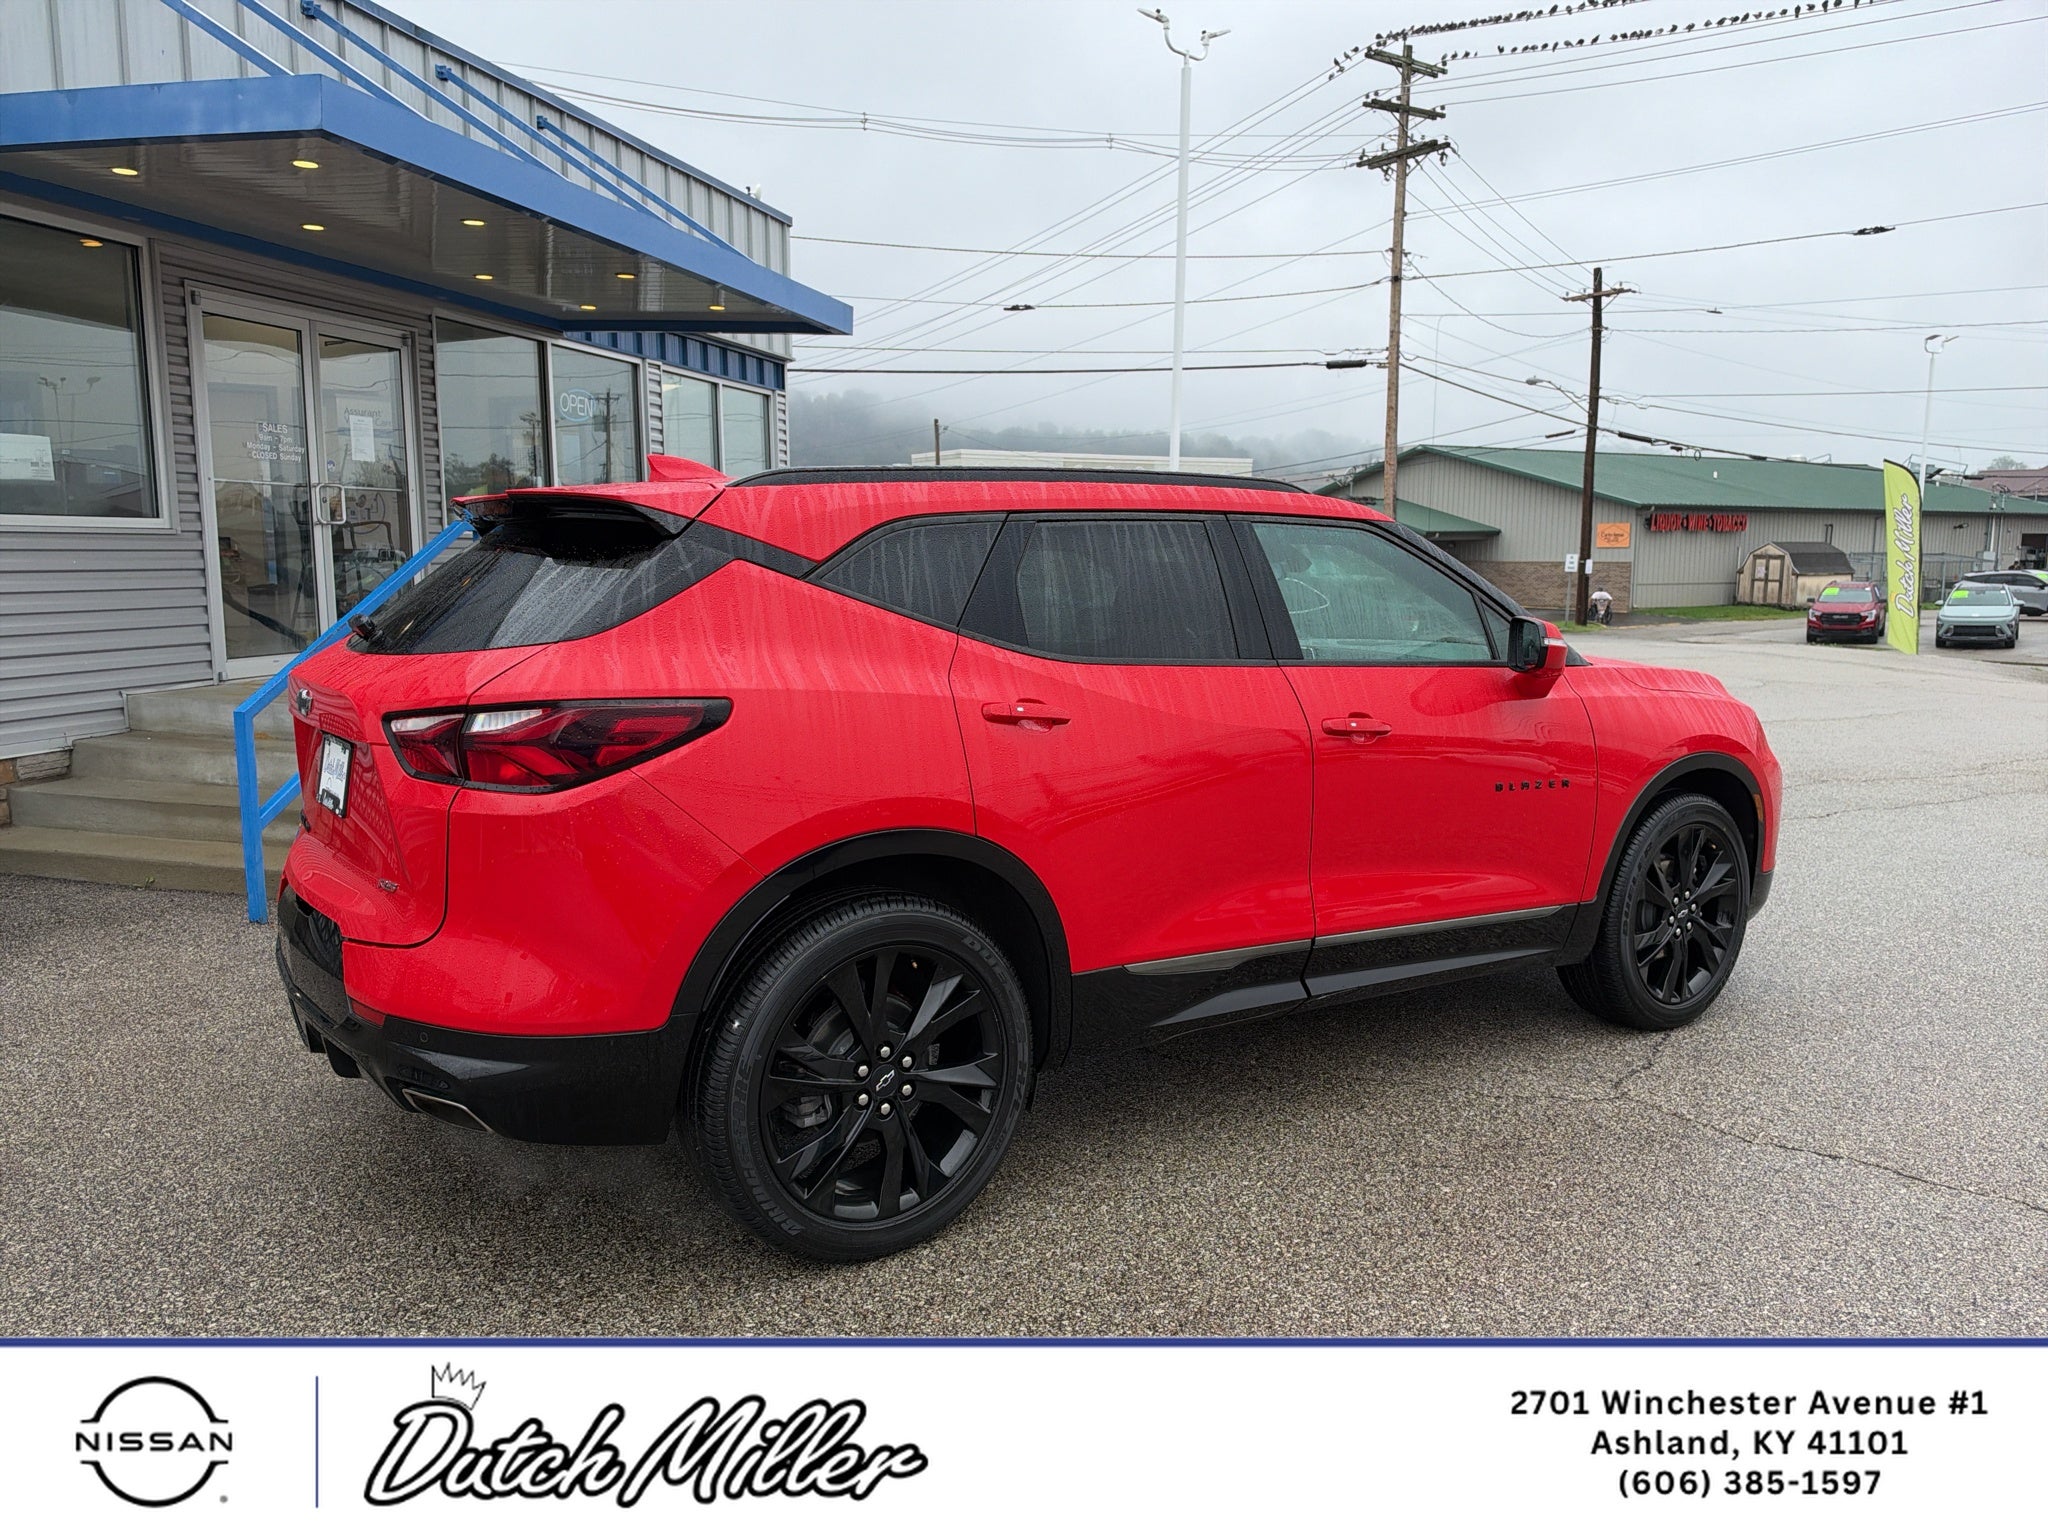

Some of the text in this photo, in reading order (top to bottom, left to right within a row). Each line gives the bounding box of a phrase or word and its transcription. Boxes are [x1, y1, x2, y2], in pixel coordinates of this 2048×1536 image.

[560, 392, 593, 417] OPEN
[262, 422, 288, 434] SALES
[246, 441, 270, 452] Monday
[278, 444, 305, 455] Saturday
[251, 450, 302, 464] CLOSED Sunday
[1650, 513, 1748, 532] LIQUOR WINE TOBACCO
[1893, 493, 1916, 619] Dutch Miller
[1494, 778, 1571, 793] BLAZER
